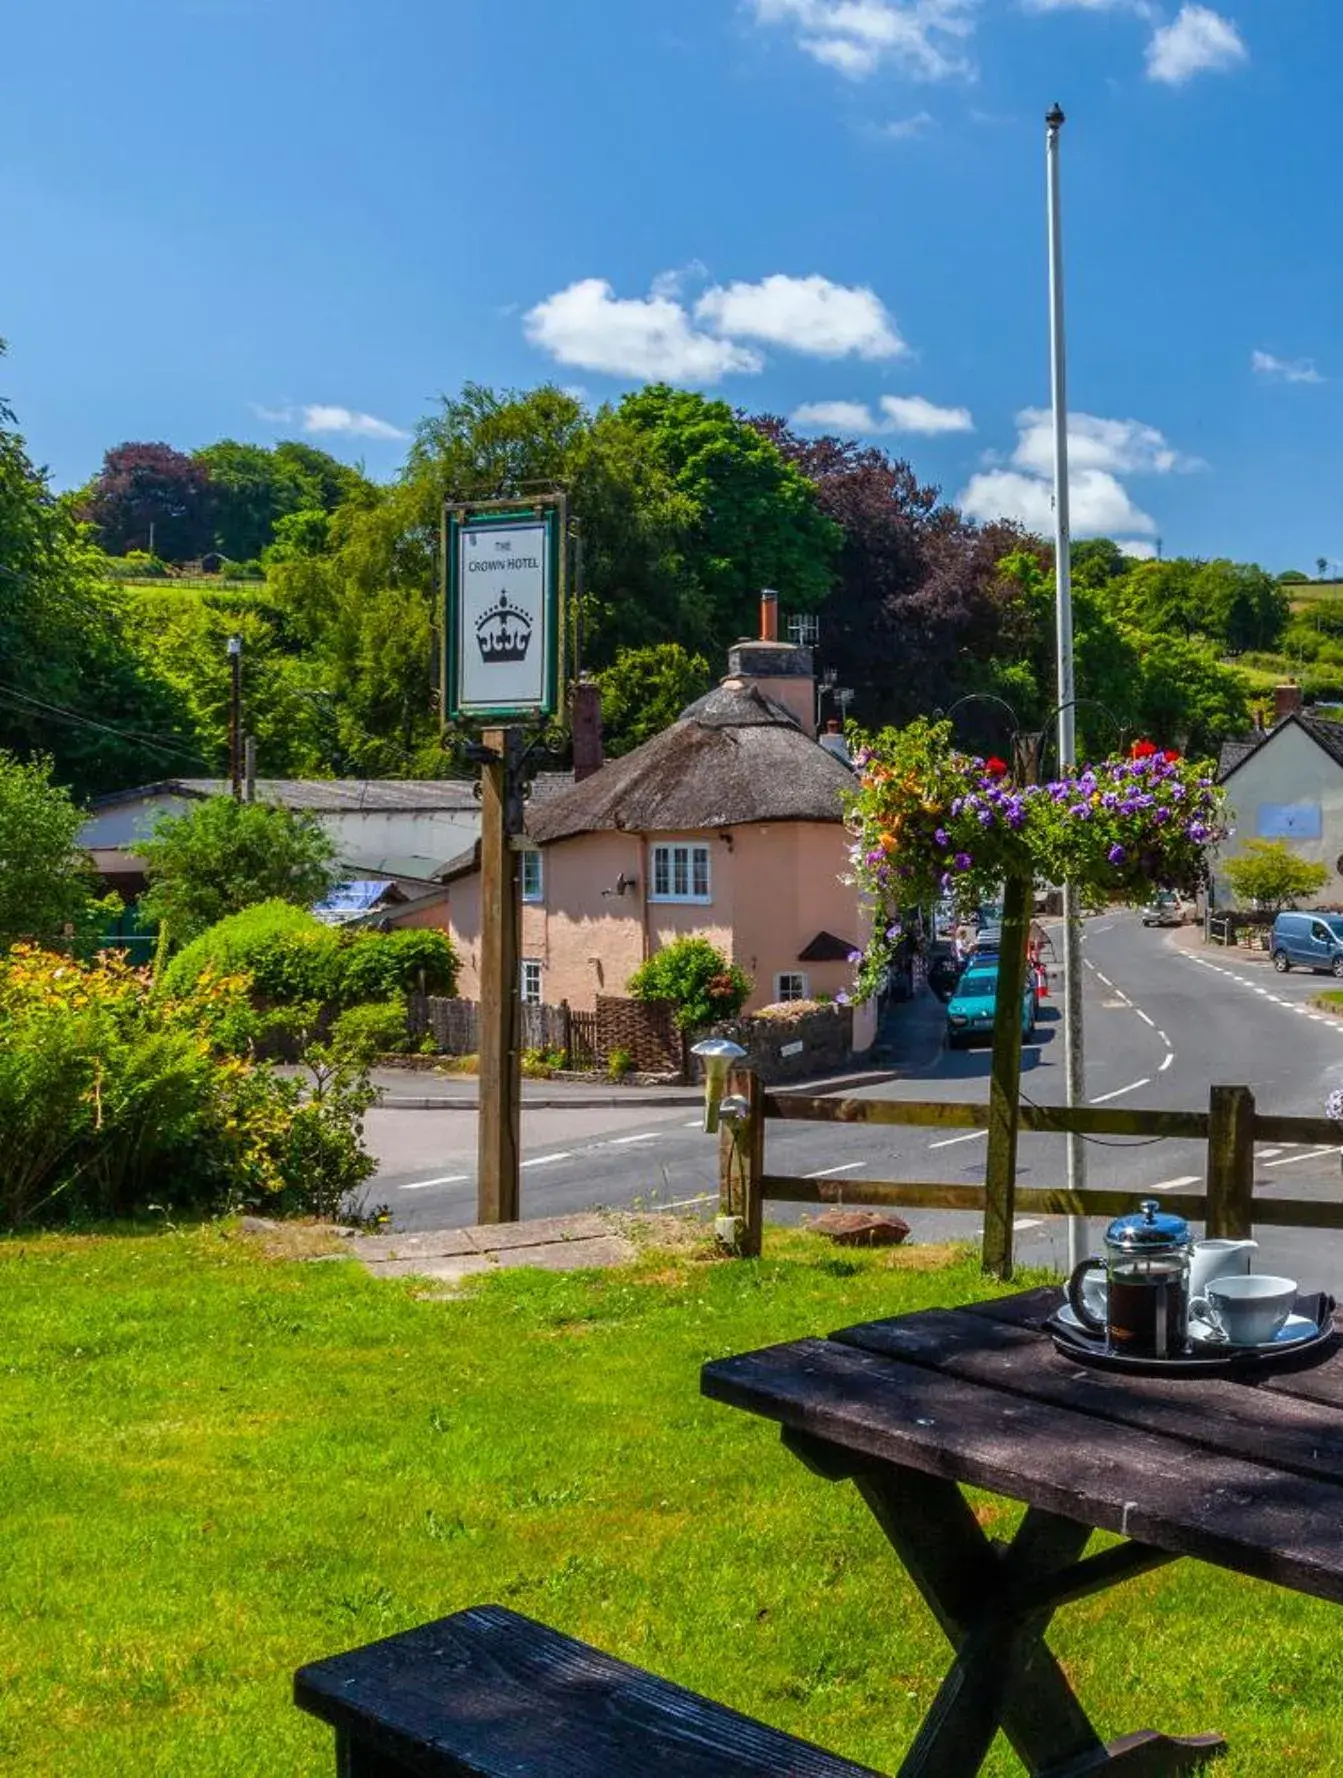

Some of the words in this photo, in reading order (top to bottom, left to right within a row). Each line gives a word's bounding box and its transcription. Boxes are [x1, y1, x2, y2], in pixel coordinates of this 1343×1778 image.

[495, 541, 511, 551] THE
[469, 560, 505, 572] CROWN
[507, 558, 540, 570] HOTEL
